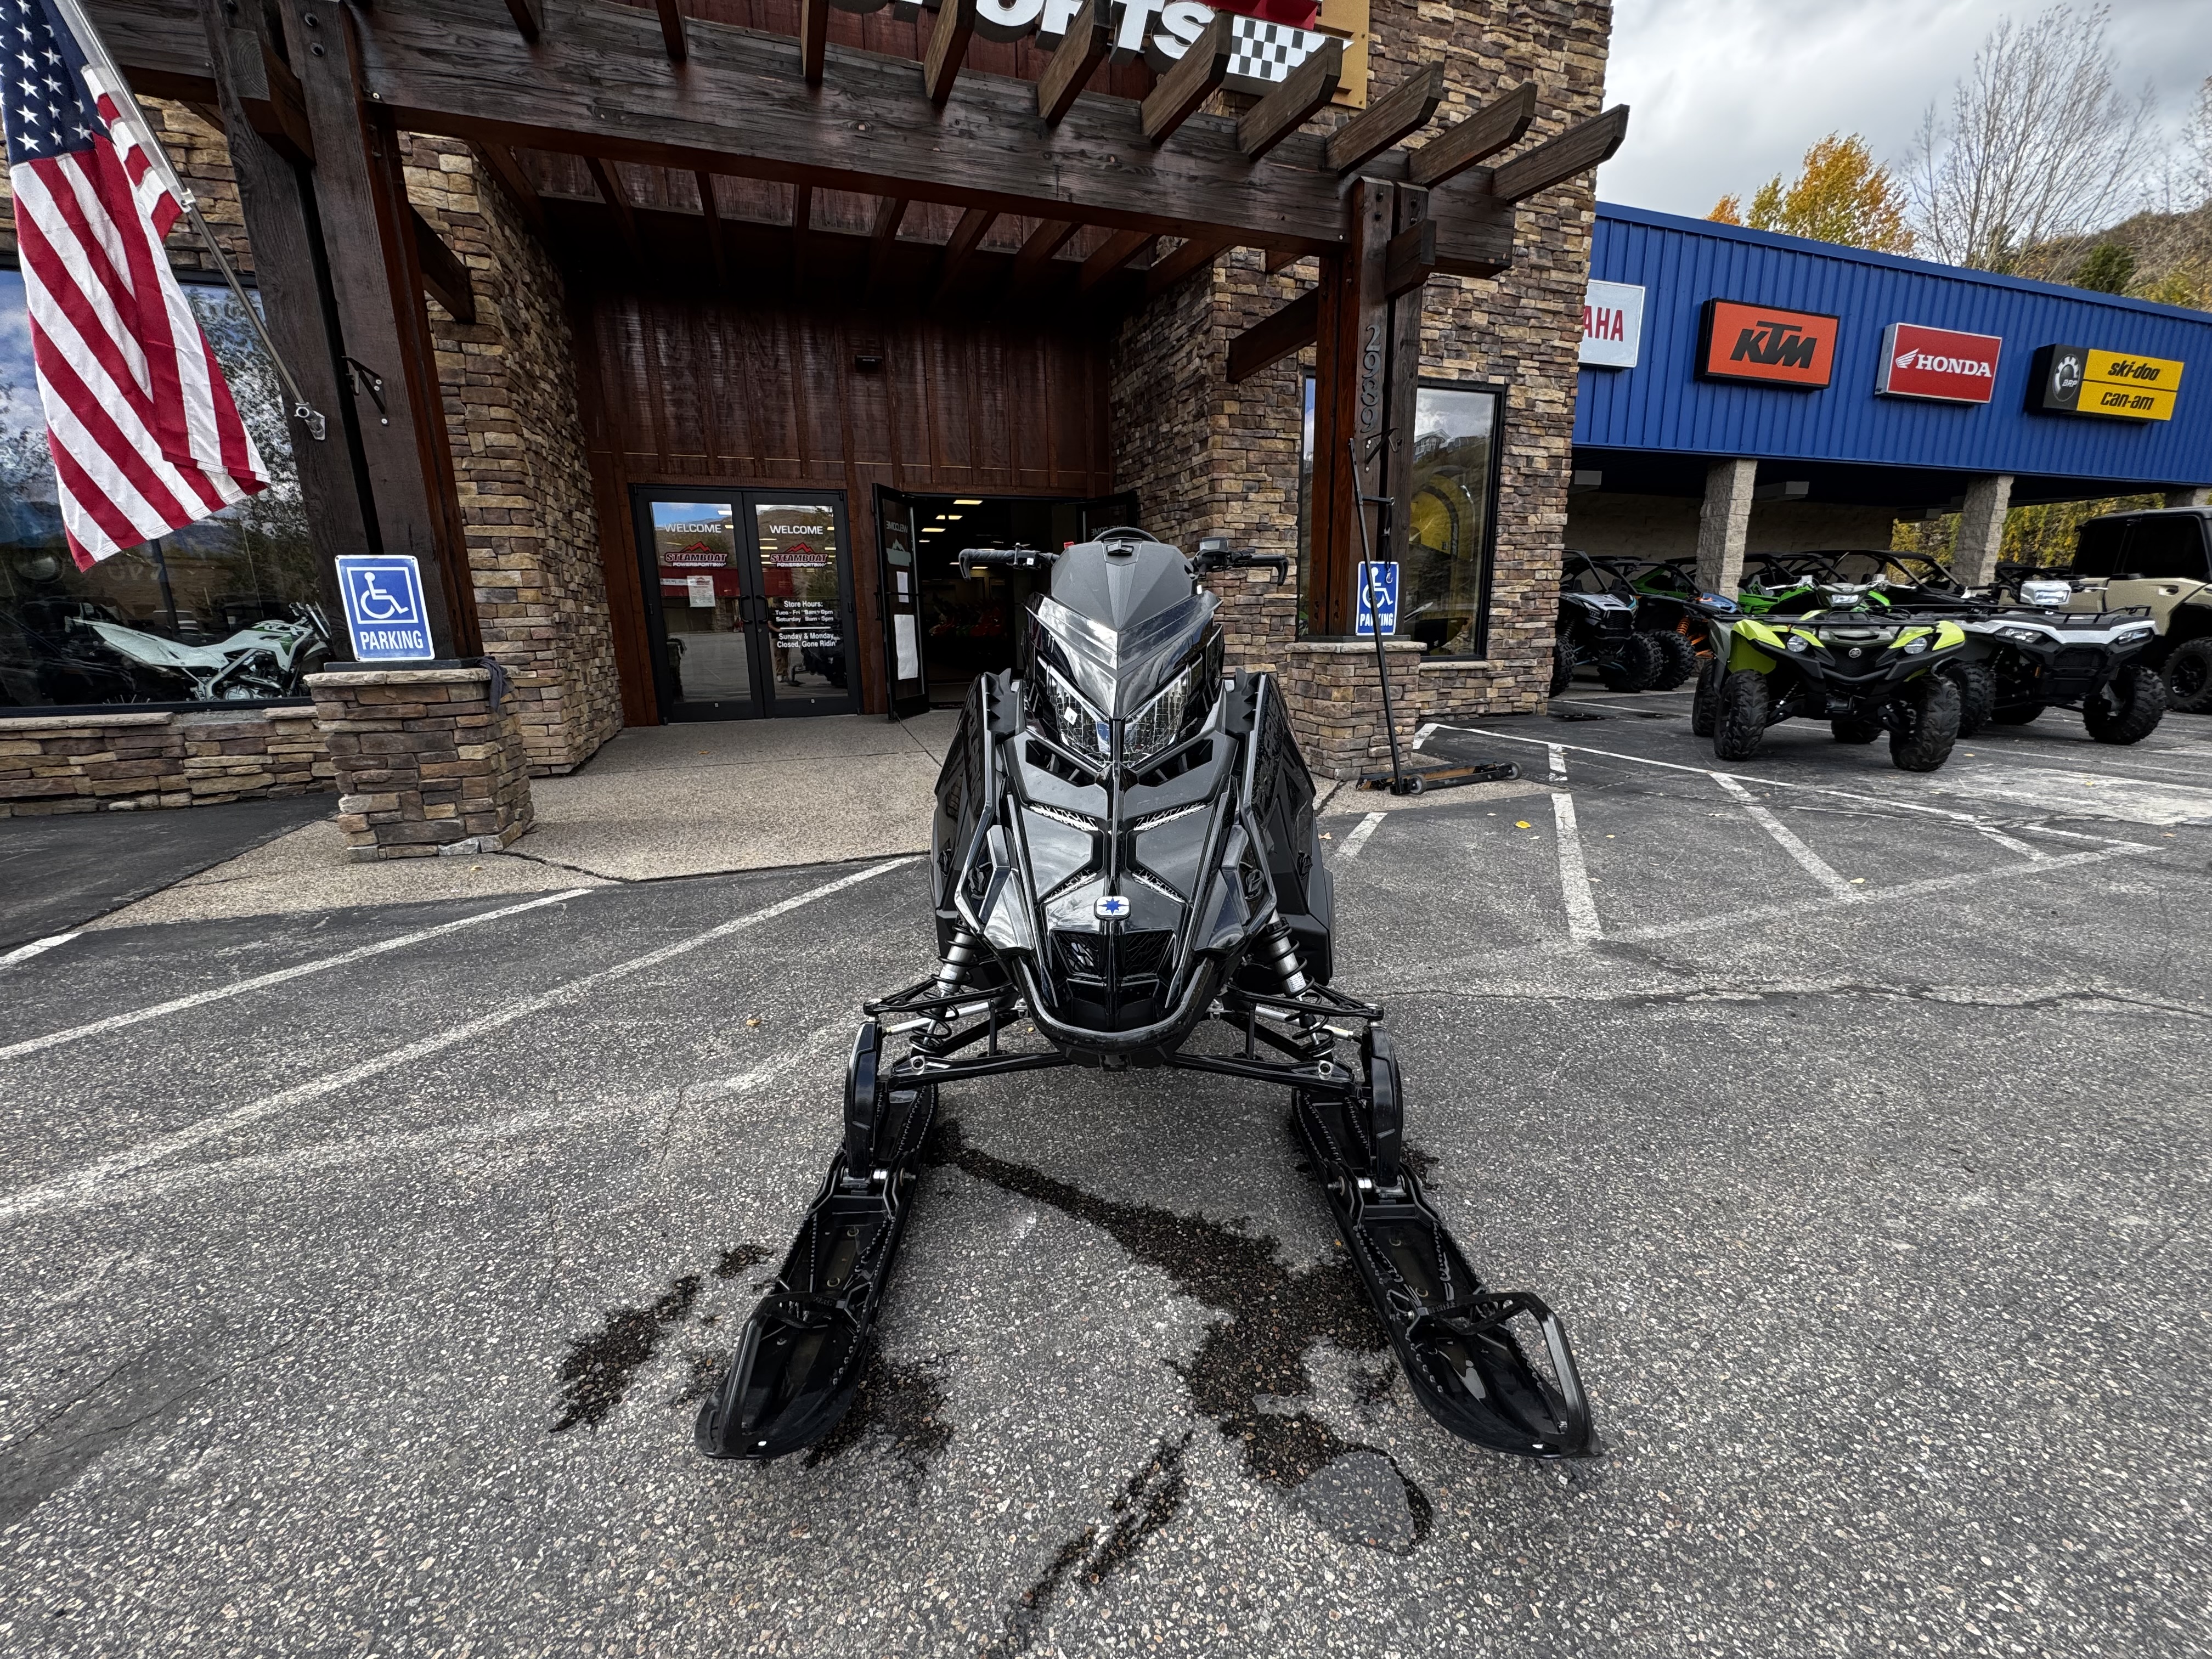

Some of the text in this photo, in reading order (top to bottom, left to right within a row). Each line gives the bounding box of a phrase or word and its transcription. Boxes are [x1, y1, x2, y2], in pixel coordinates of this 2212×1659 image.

[1729, 320, 1817, 369] KTM
[1915, 354, 1992, 378] HONDA
[2107, 360, 2161, 381] ski-doo
[1361, 324, 1381, 433] 2989
[2062, 379, 2078, 387] BRP
[664, 523, 722, 533] WELCOME
[769, 525, 823, 534] WELCOME
[665, 552, 728, 562] STEAMBOAT
[770, 554, 828, 562] STEAMBOAT
[360, 630, 424, 650] PARKING
[778, 633, 802, 641] Sunday
